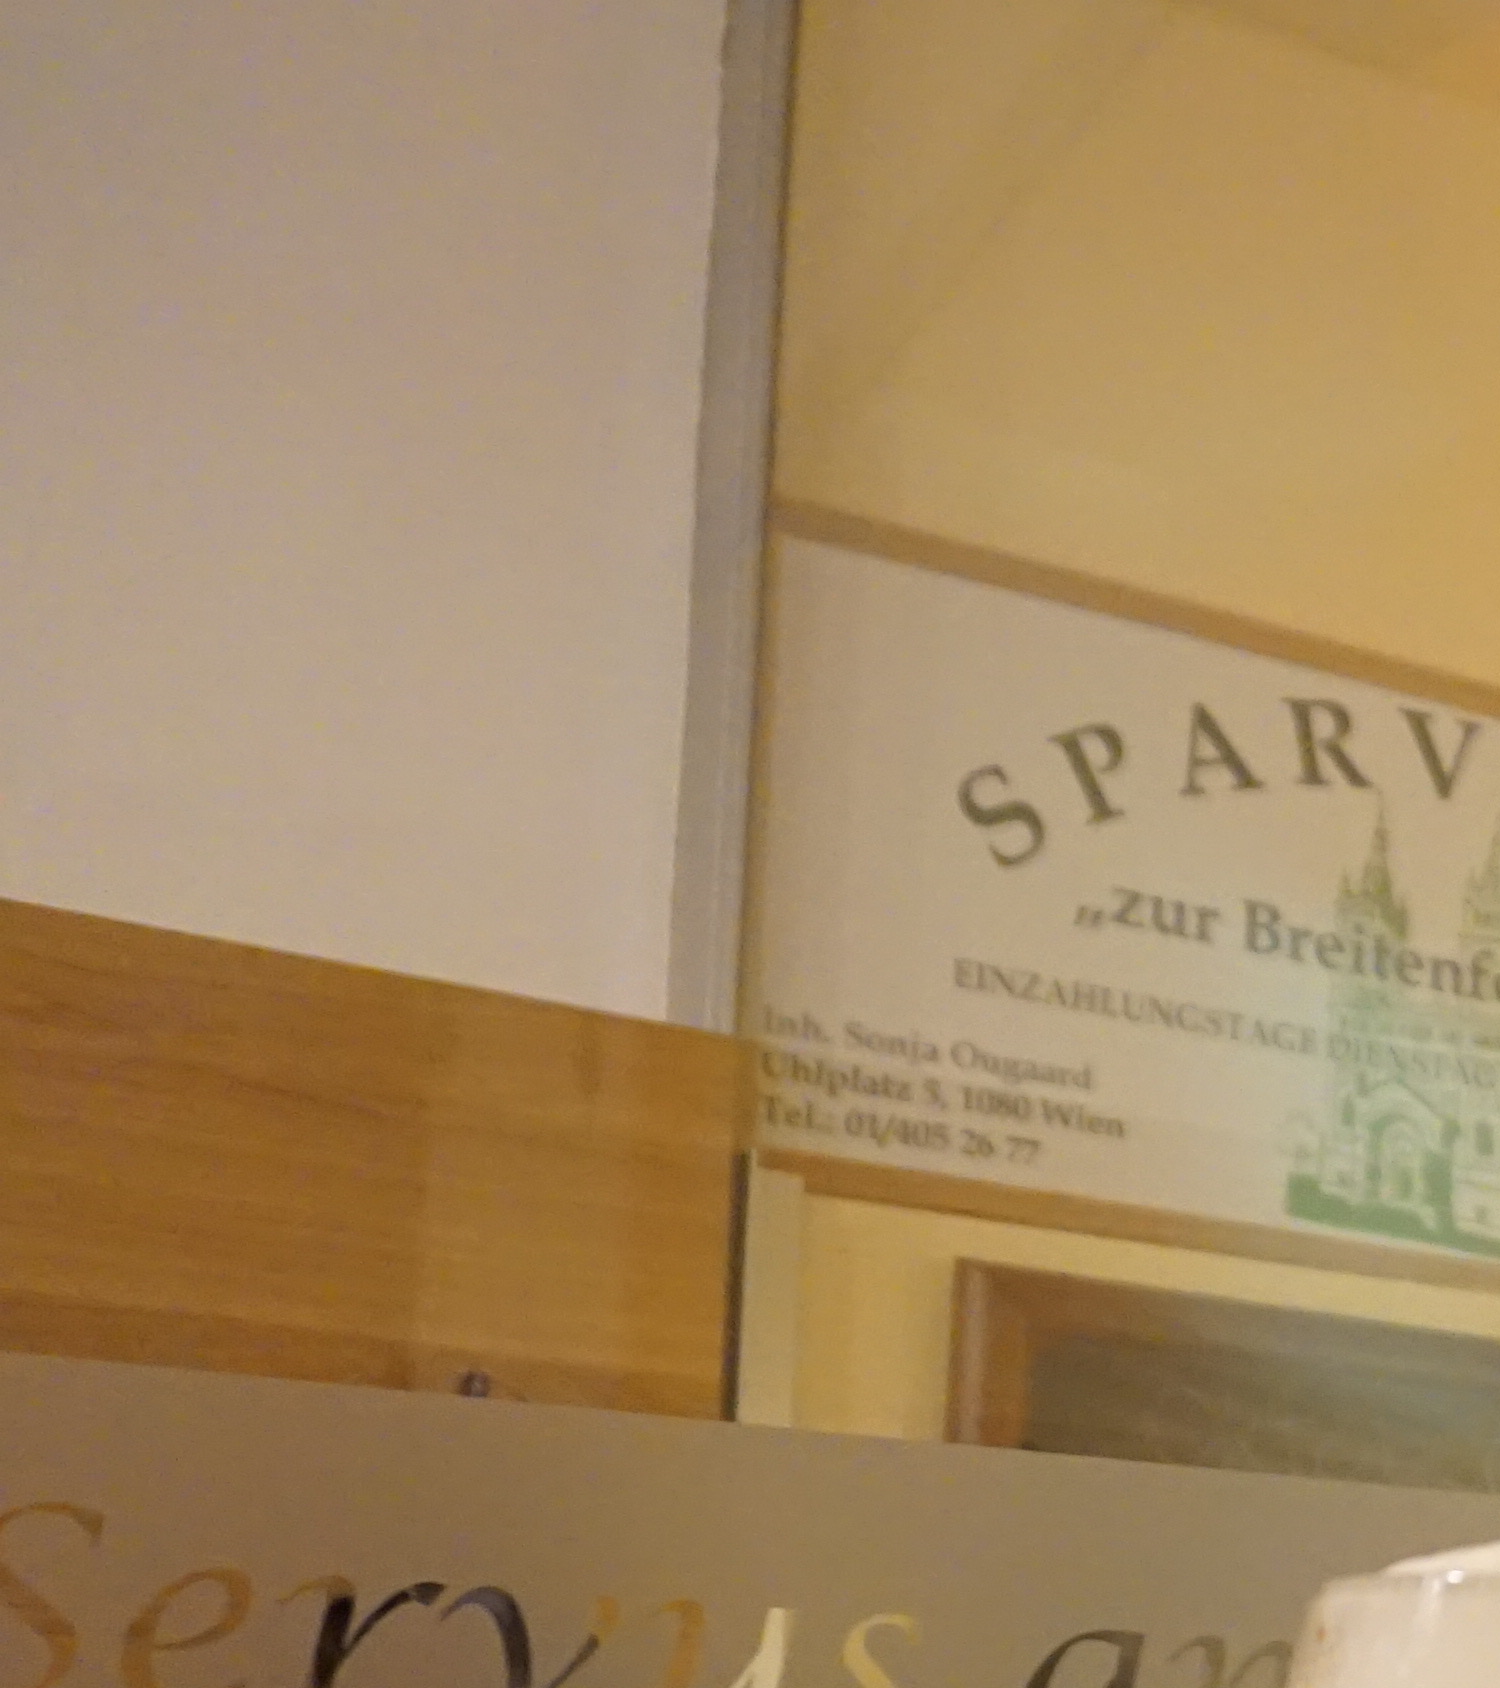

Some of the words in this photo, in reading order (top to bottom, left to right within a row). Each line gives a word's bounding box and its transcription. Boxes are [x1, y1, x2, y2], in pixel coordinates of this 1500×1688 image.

[953, 957, 1318, 1054] EINZAHLUNGSTAGE
[844, 1021, 940, 1064] Sonja
[761, 1050, 911, 1101] Uhlplatz
[1041, 1096, 1126, 1138] Wien
[1006, 1134, 1042, 1165] 77
